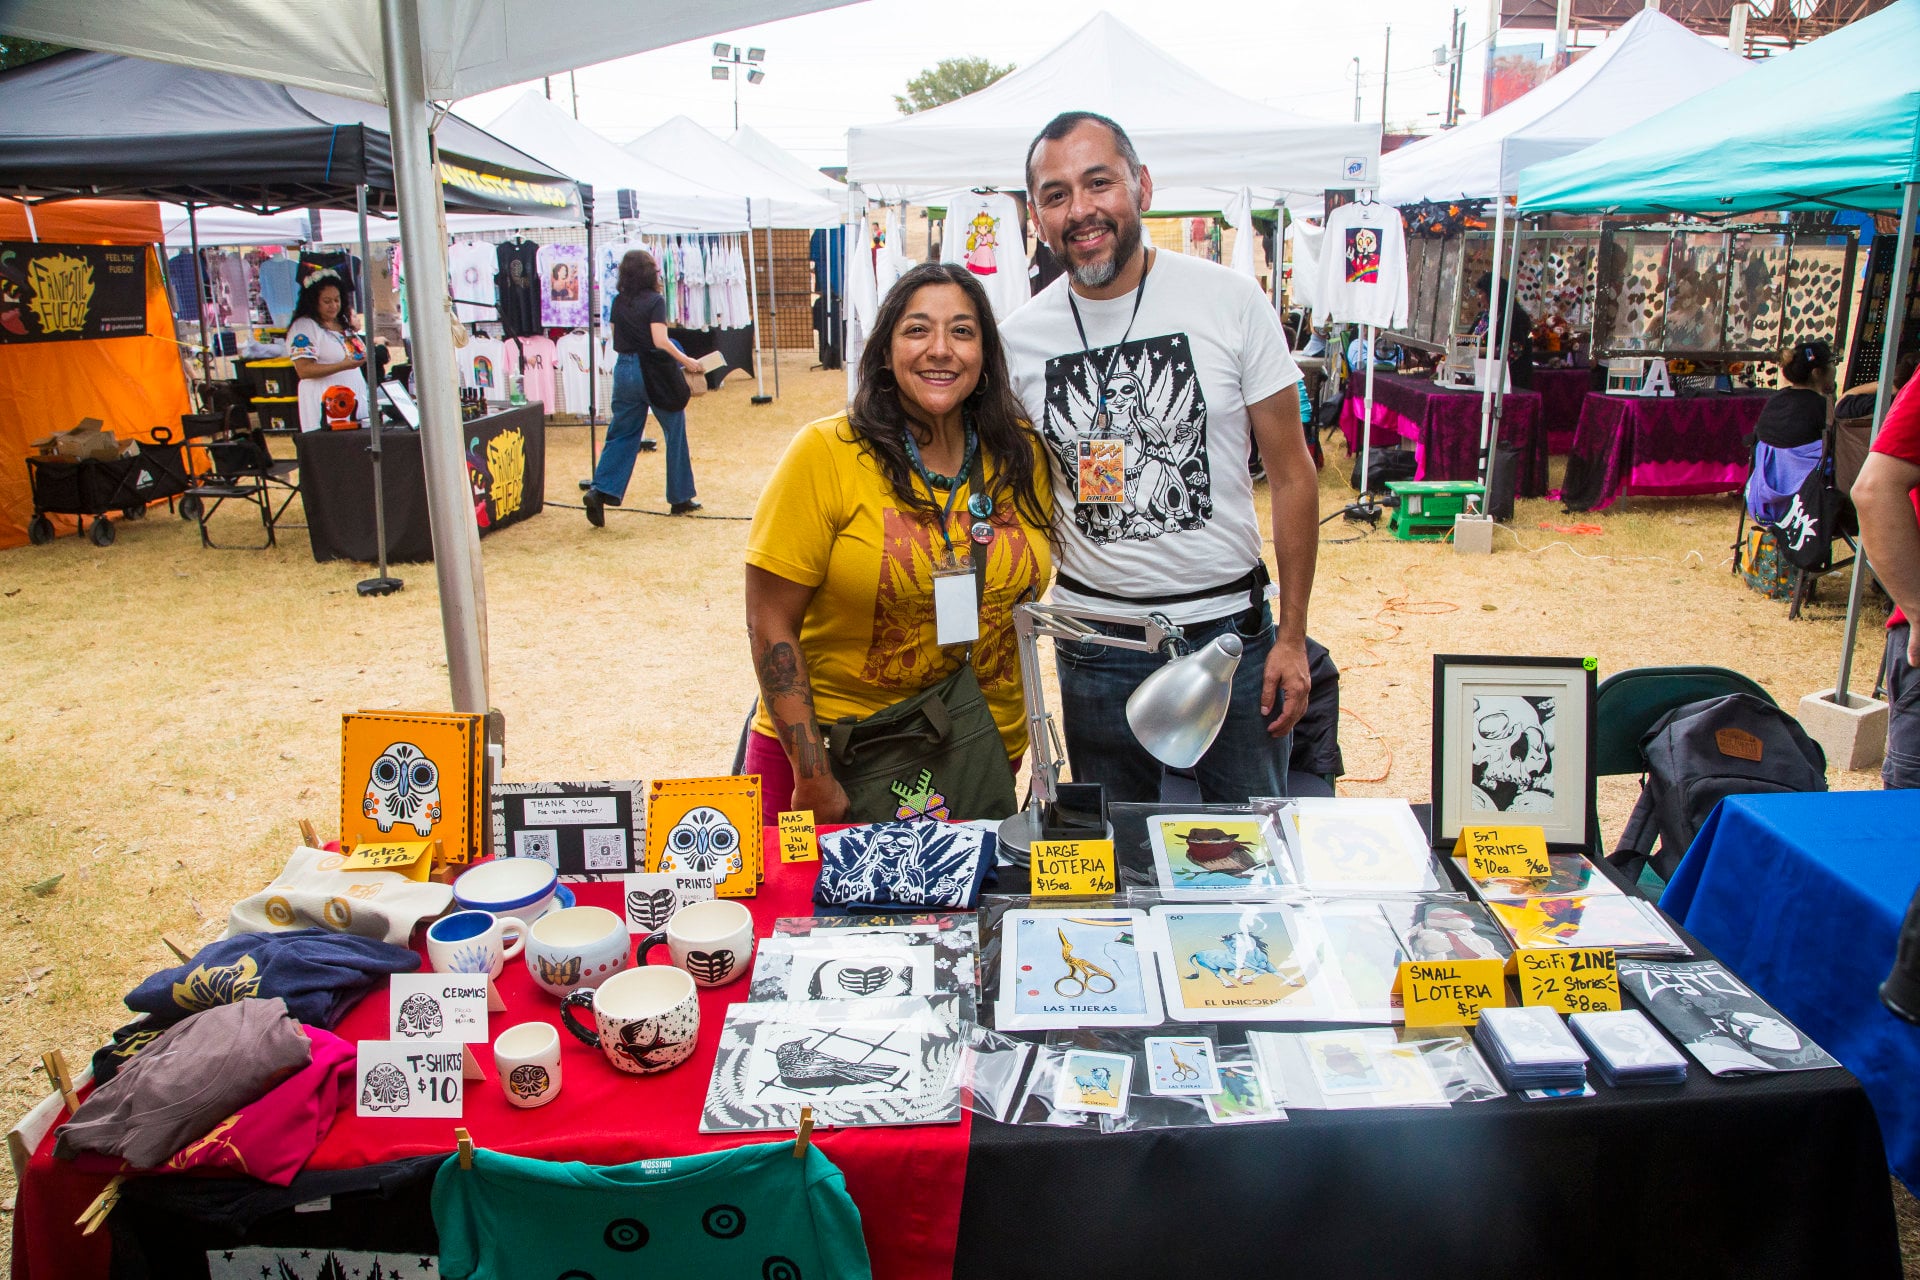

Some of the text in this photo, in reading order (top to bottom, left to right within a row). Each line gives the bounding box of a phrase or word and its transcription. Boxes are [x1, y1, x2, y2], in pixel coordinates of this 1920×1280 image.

[440, 160, 519, 199] ANTASTIC
[105, 253, 135, 263] FEEL THE
[32, 261, 89, 301] FANTASTIC
[40, 301, 86, 330] FUEGO
[1585, 660, 1596, 668] 25
[530, 799, 594, 808] THANK YOU
[781, 814, 804, 824] MAS
[1473, 830, 1499, 842] 5x7
[357, 846, 407, 858] Totes
[785, 842, 809, 853] BIN
[1036, 843, 1080, 858] LARGE
[1473, 844, 1529, 856] PRINTS
[1037, 858, 1106, 875] LOTERIA
[676, 877, 713, 890] PRINTS
[1568, 950, 1616, 973] ZINE
[1618, 962, 1719, 973] ABSOLUTE
[1409, 965, 1462, 981] SMALL
[1544, 976, 1608, 993] 2 Stories
[1620, 969, 1753, 1002] ZERO
[442, 987, 487, 999] CERAMICS
[1412, 983, 1493, 1003] LOTERIA
[406, 1052, 462, 1074] T-SHIRTS
[417, 1076, 458, 1104] $10
[640, 1160, 672, 1169] MOSSIMO
